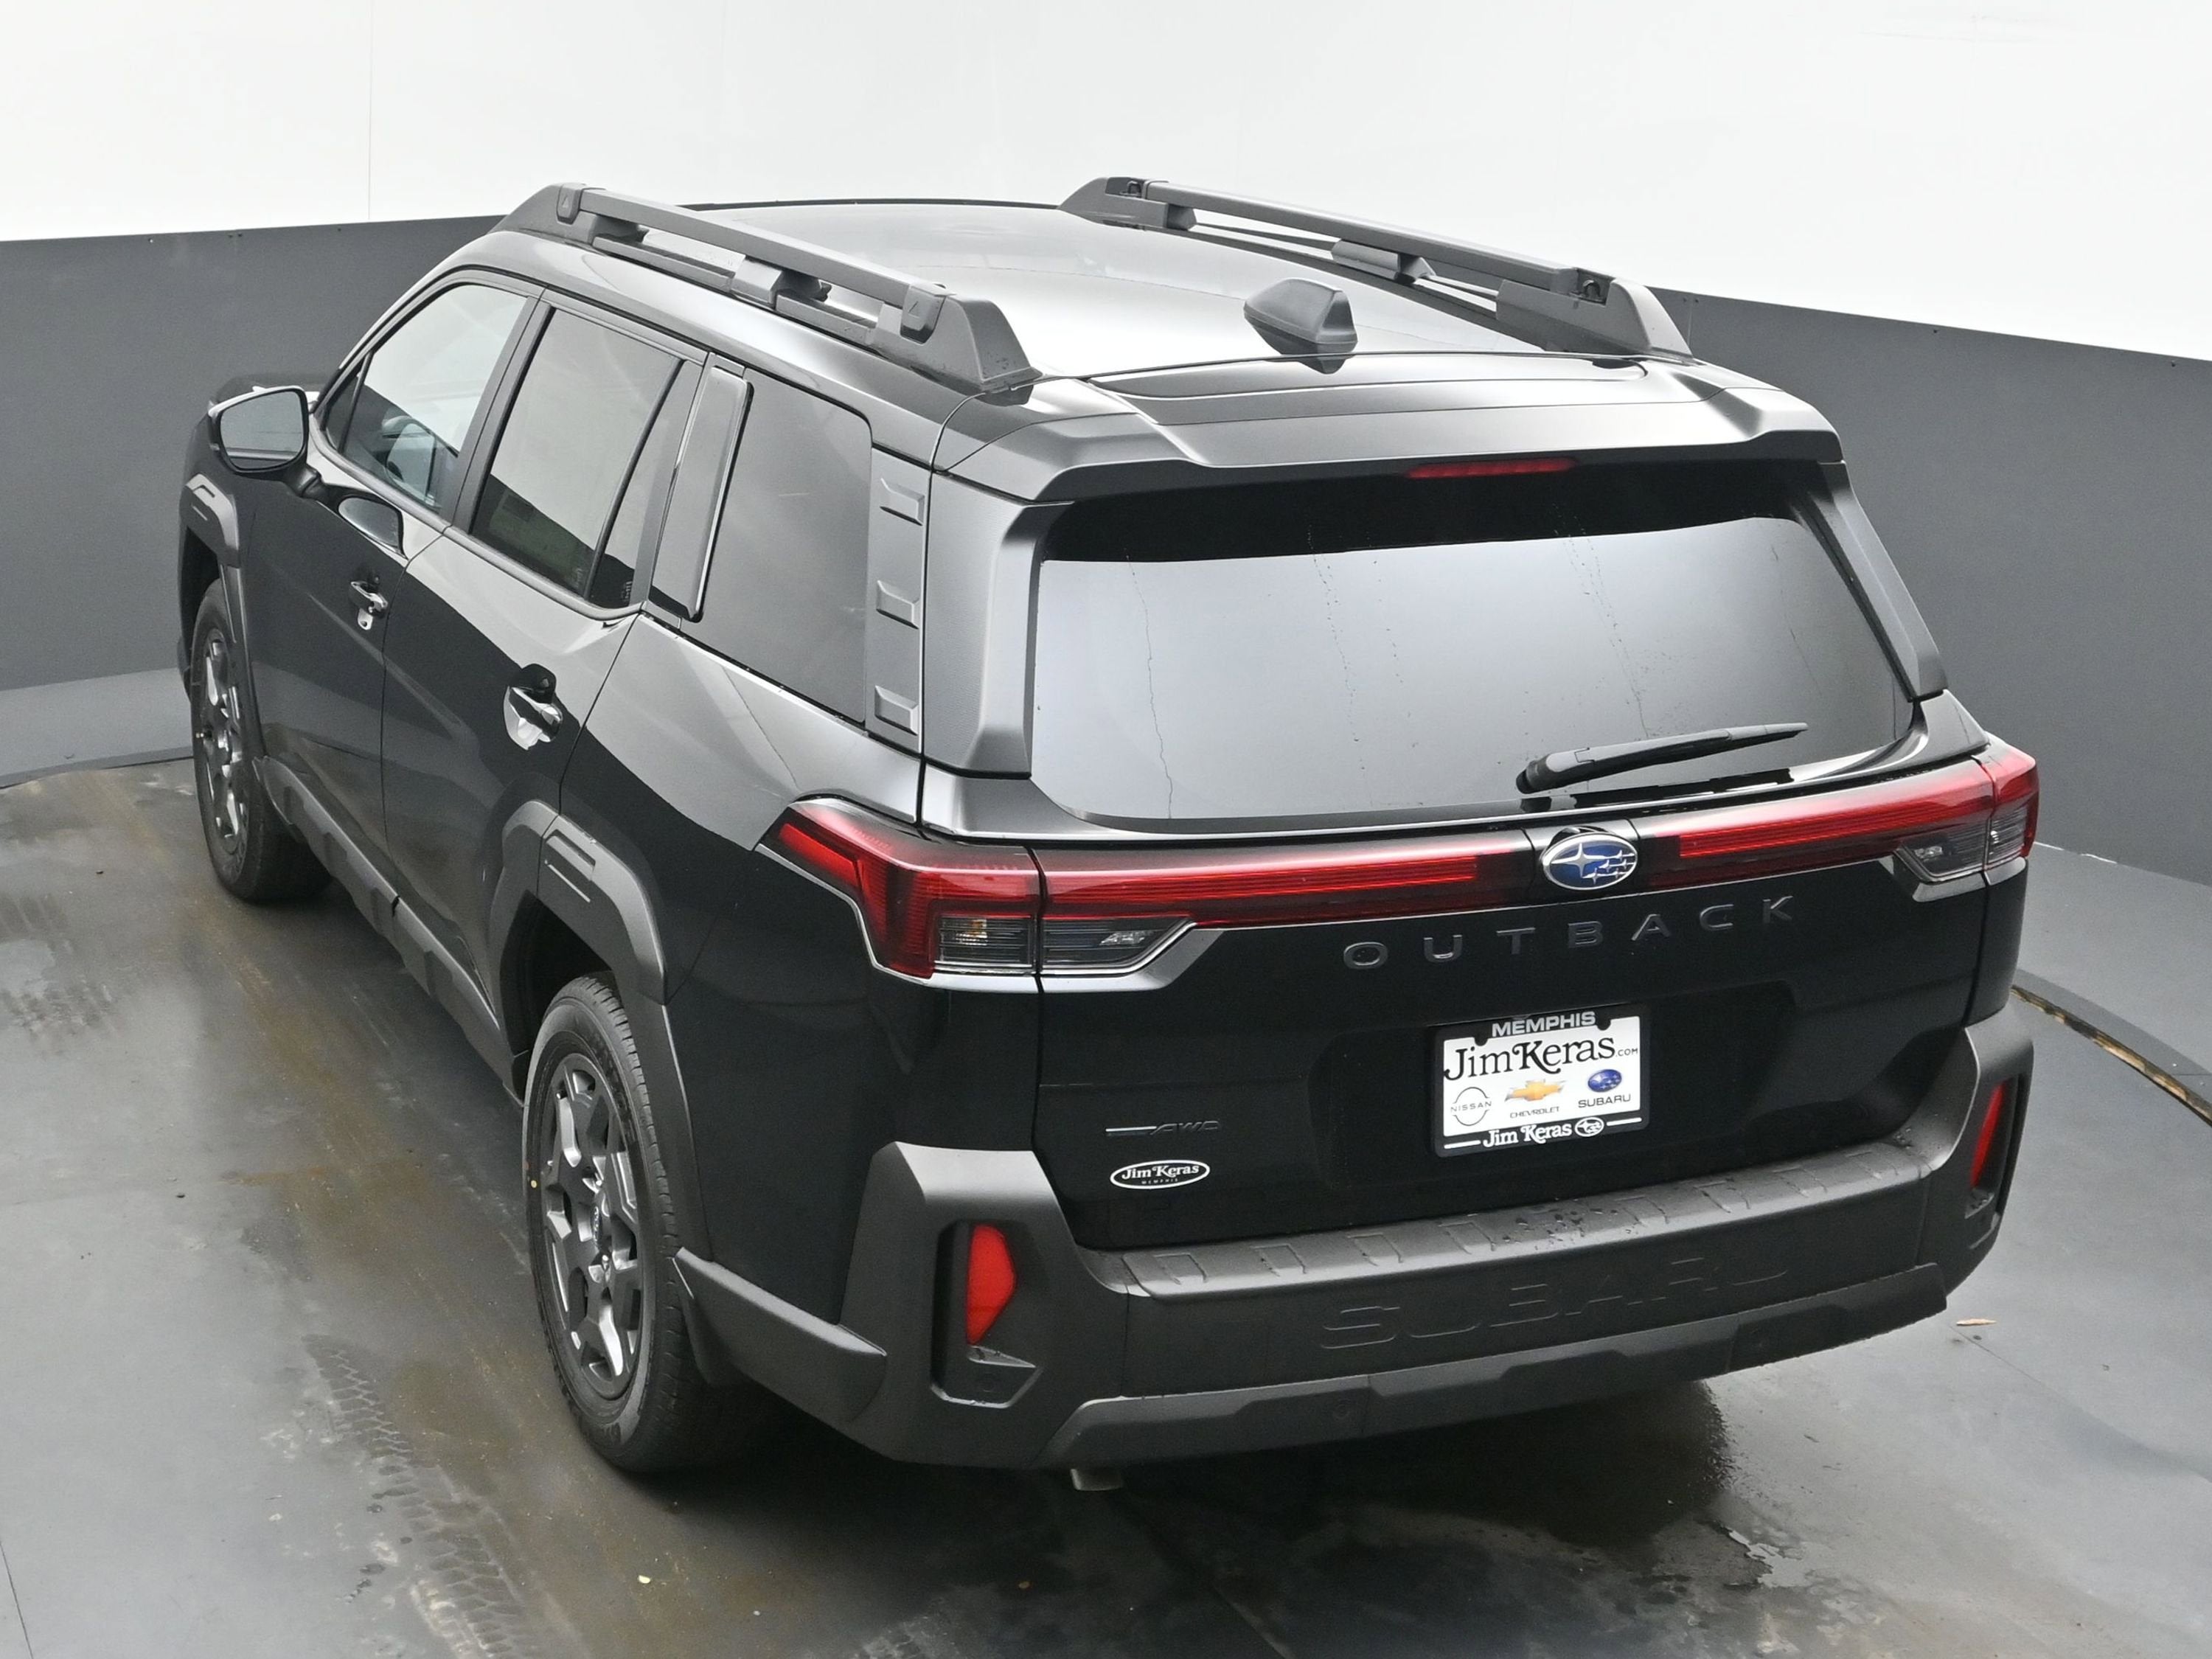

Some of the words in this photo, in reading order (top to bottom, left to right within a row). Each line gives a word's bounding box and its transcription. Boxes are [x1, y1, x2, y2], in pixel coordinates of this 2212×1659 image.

[1343, 895, 1794, 969] OUTBACK
[1491, 1011, 1596, 1037] MEMPHIS
[1450, 1099, 1492, 1113] NISSAN
[1577, 1093, 1632, 1108] SUBARU
[1509, 1106, 1560, 1119] CHEVROLET
[1483, 1130, 1519, 1148] Jim
[1520, 1121, 1573, 1145] Keras
